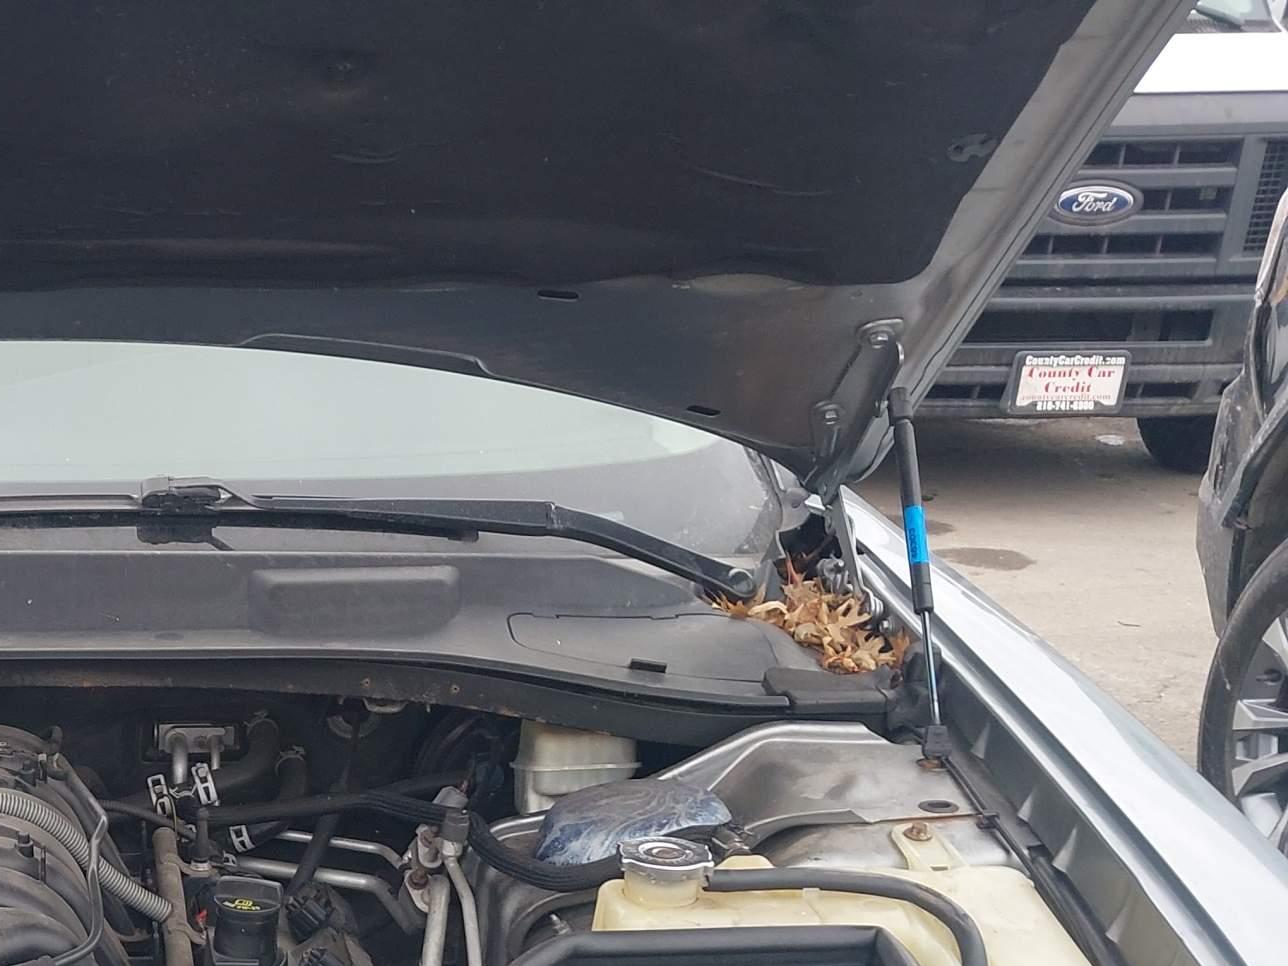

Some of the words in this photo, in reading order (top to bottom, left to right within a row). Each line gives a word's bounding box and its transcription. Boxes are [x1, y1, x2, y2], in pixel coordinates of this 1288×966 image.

[1072, 191, 1118, 212] Ford
[1025, 355, 1126, 367] CountyCarCredit.com
[1028, 367, 1080, 380] County
[1087, 366, 1116, 378] Car
[1044, 381, 1092, 393] Credit
